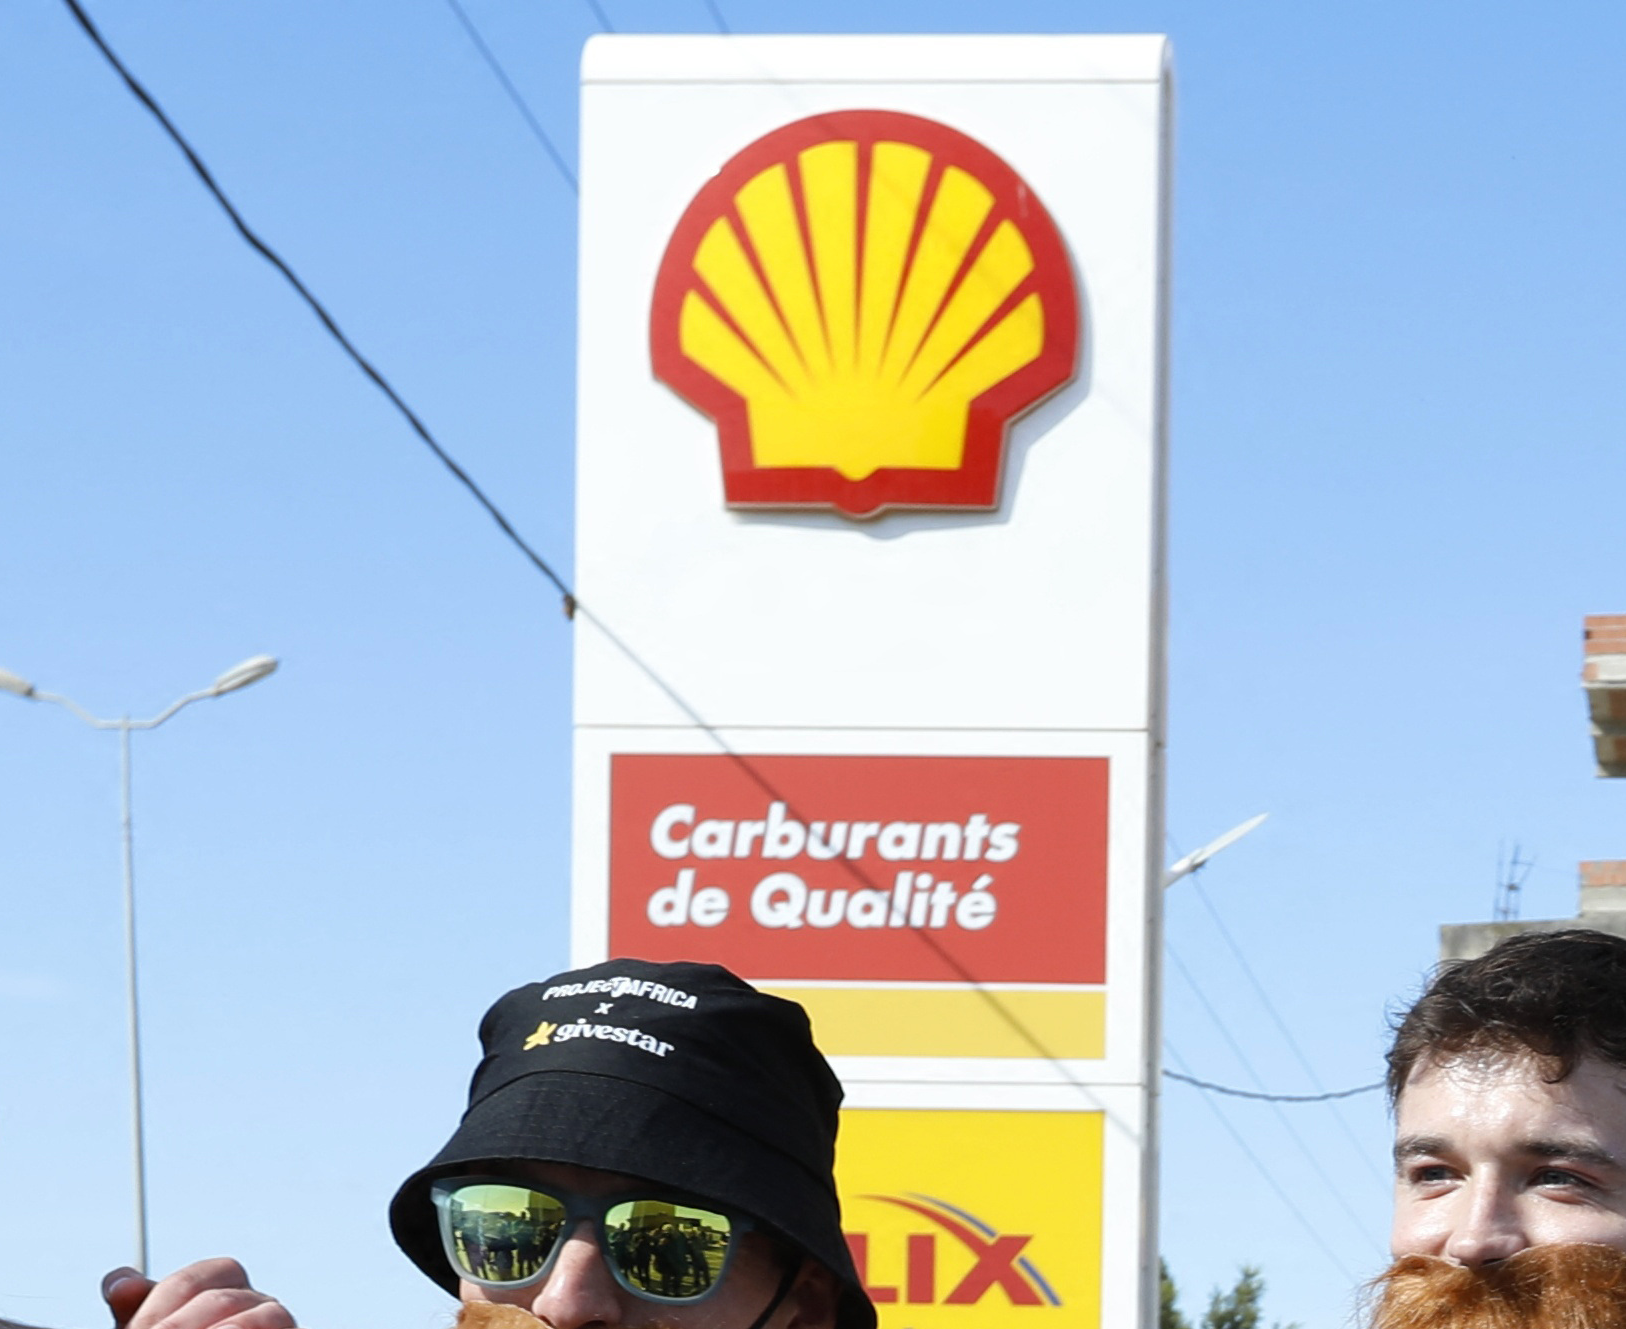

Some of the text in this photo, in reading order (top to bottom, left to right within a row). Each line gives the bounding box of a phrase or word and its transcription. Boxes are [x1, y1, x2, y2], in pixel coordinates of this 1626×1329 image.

[650, 800, 1022, 863] Carburants
[647, 868, 998, 930] de Qualité
[552, 1018, 676, 1058] givestar
